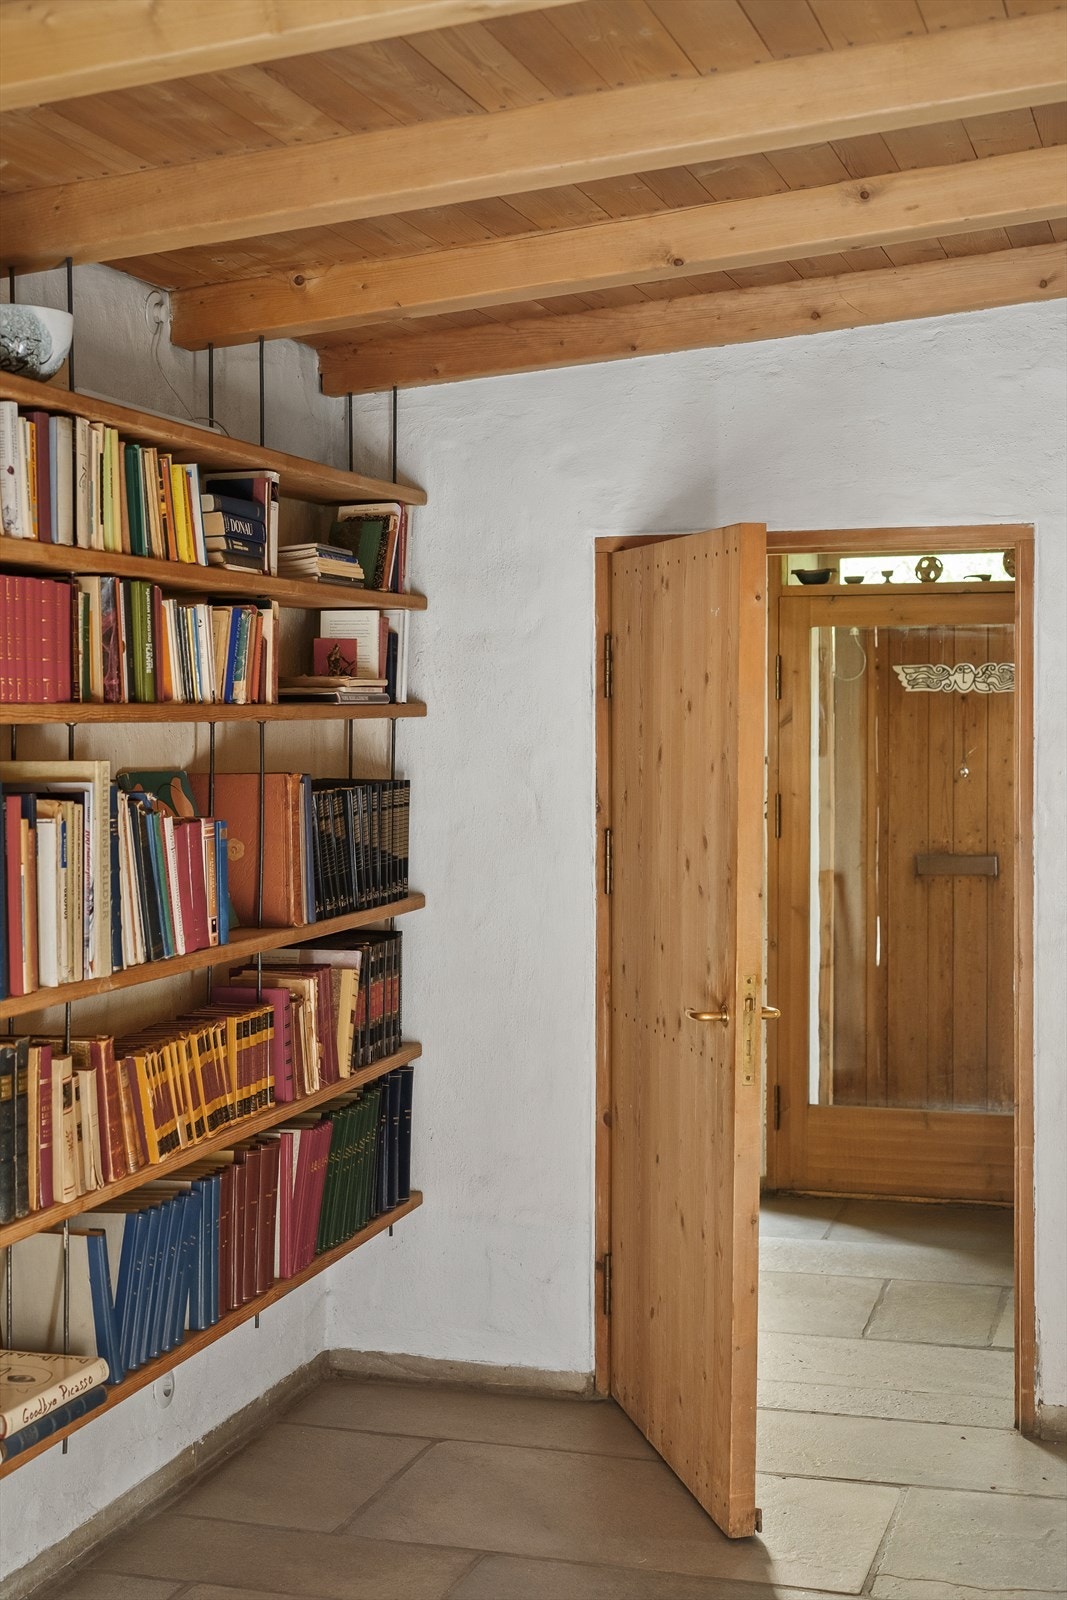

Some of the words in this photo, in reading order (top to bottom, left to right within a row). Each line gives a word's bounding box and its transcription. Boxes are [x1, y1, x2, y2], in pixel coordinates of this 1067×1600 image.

[231, 519, 253, 535] DONAU
[22, 1398, 58, 1424] Goodbye
[58, 1376, 94, 1400] Picasso
